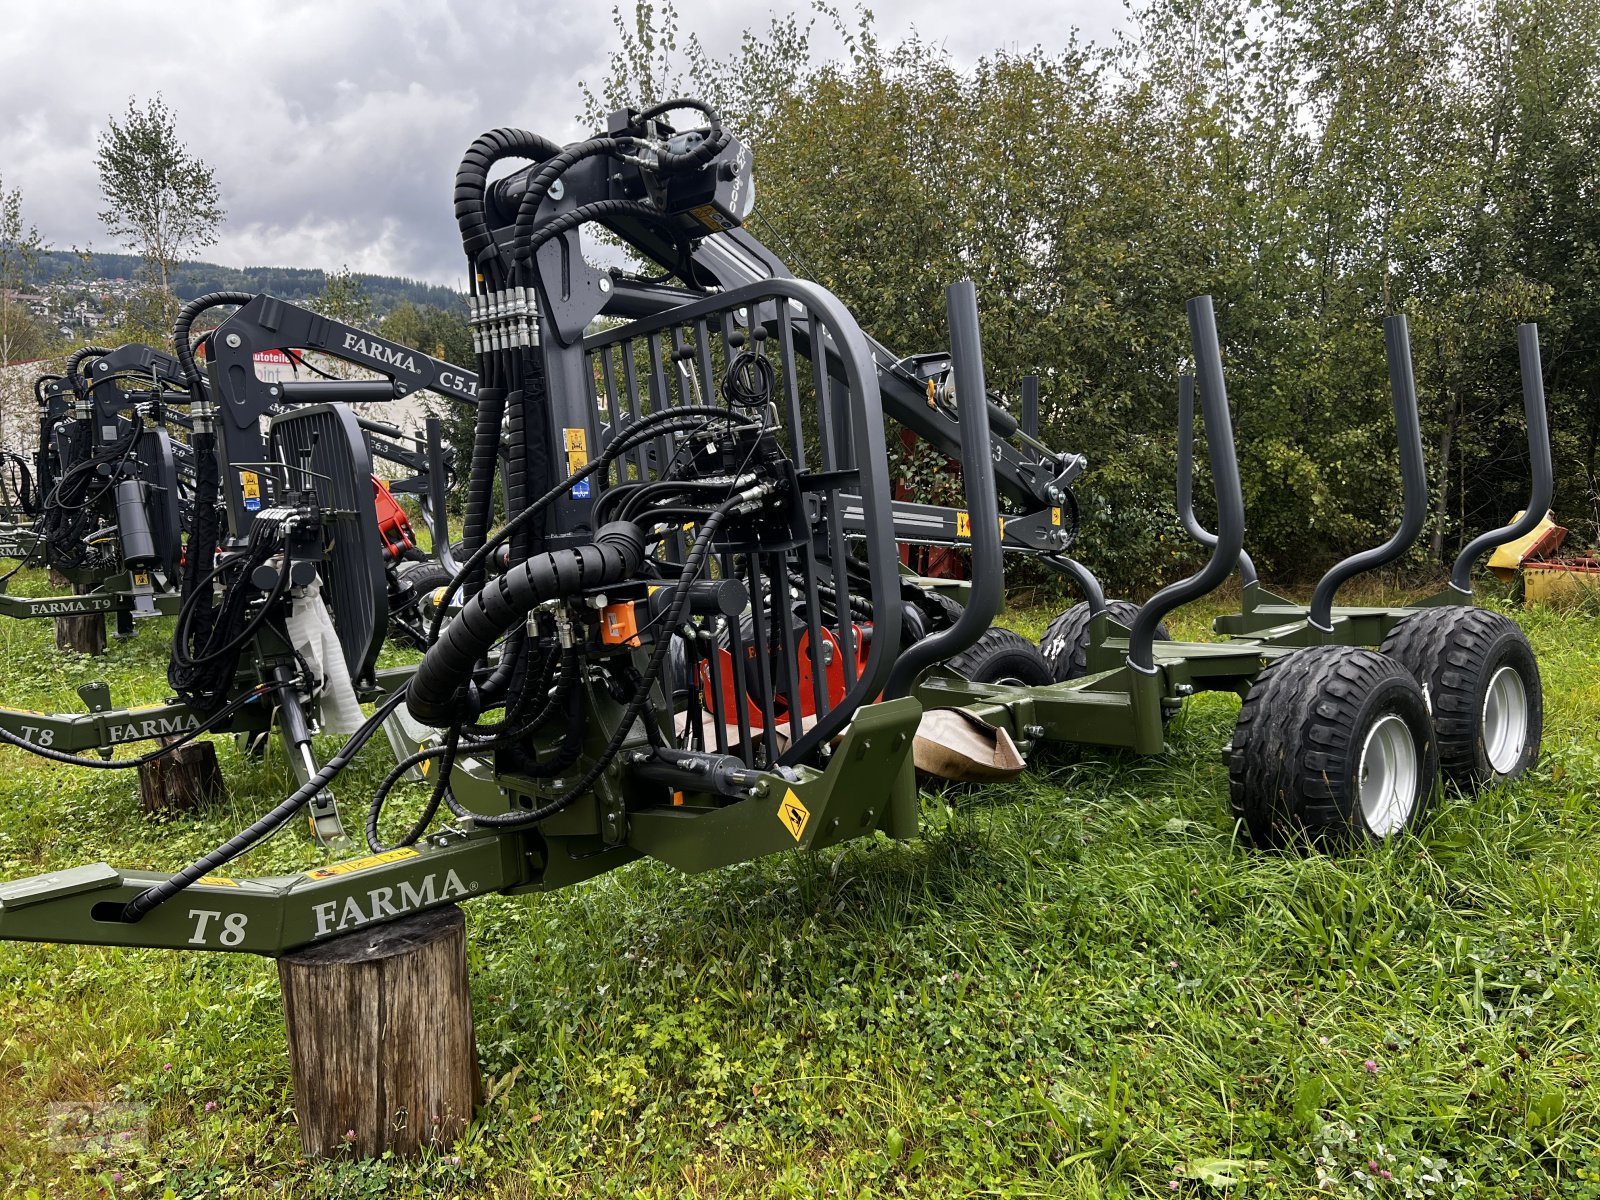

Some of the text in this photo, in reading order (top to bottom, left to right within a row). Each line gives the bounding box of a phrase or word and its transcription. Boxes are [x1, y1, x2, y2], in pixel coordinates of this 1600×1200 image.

[439, 372, 477, 397] C5.1
[91, 600, 111, 610] T9
[20, 713, 201, 746] T8 FARMA
[188, 909, 248, 946] T8
